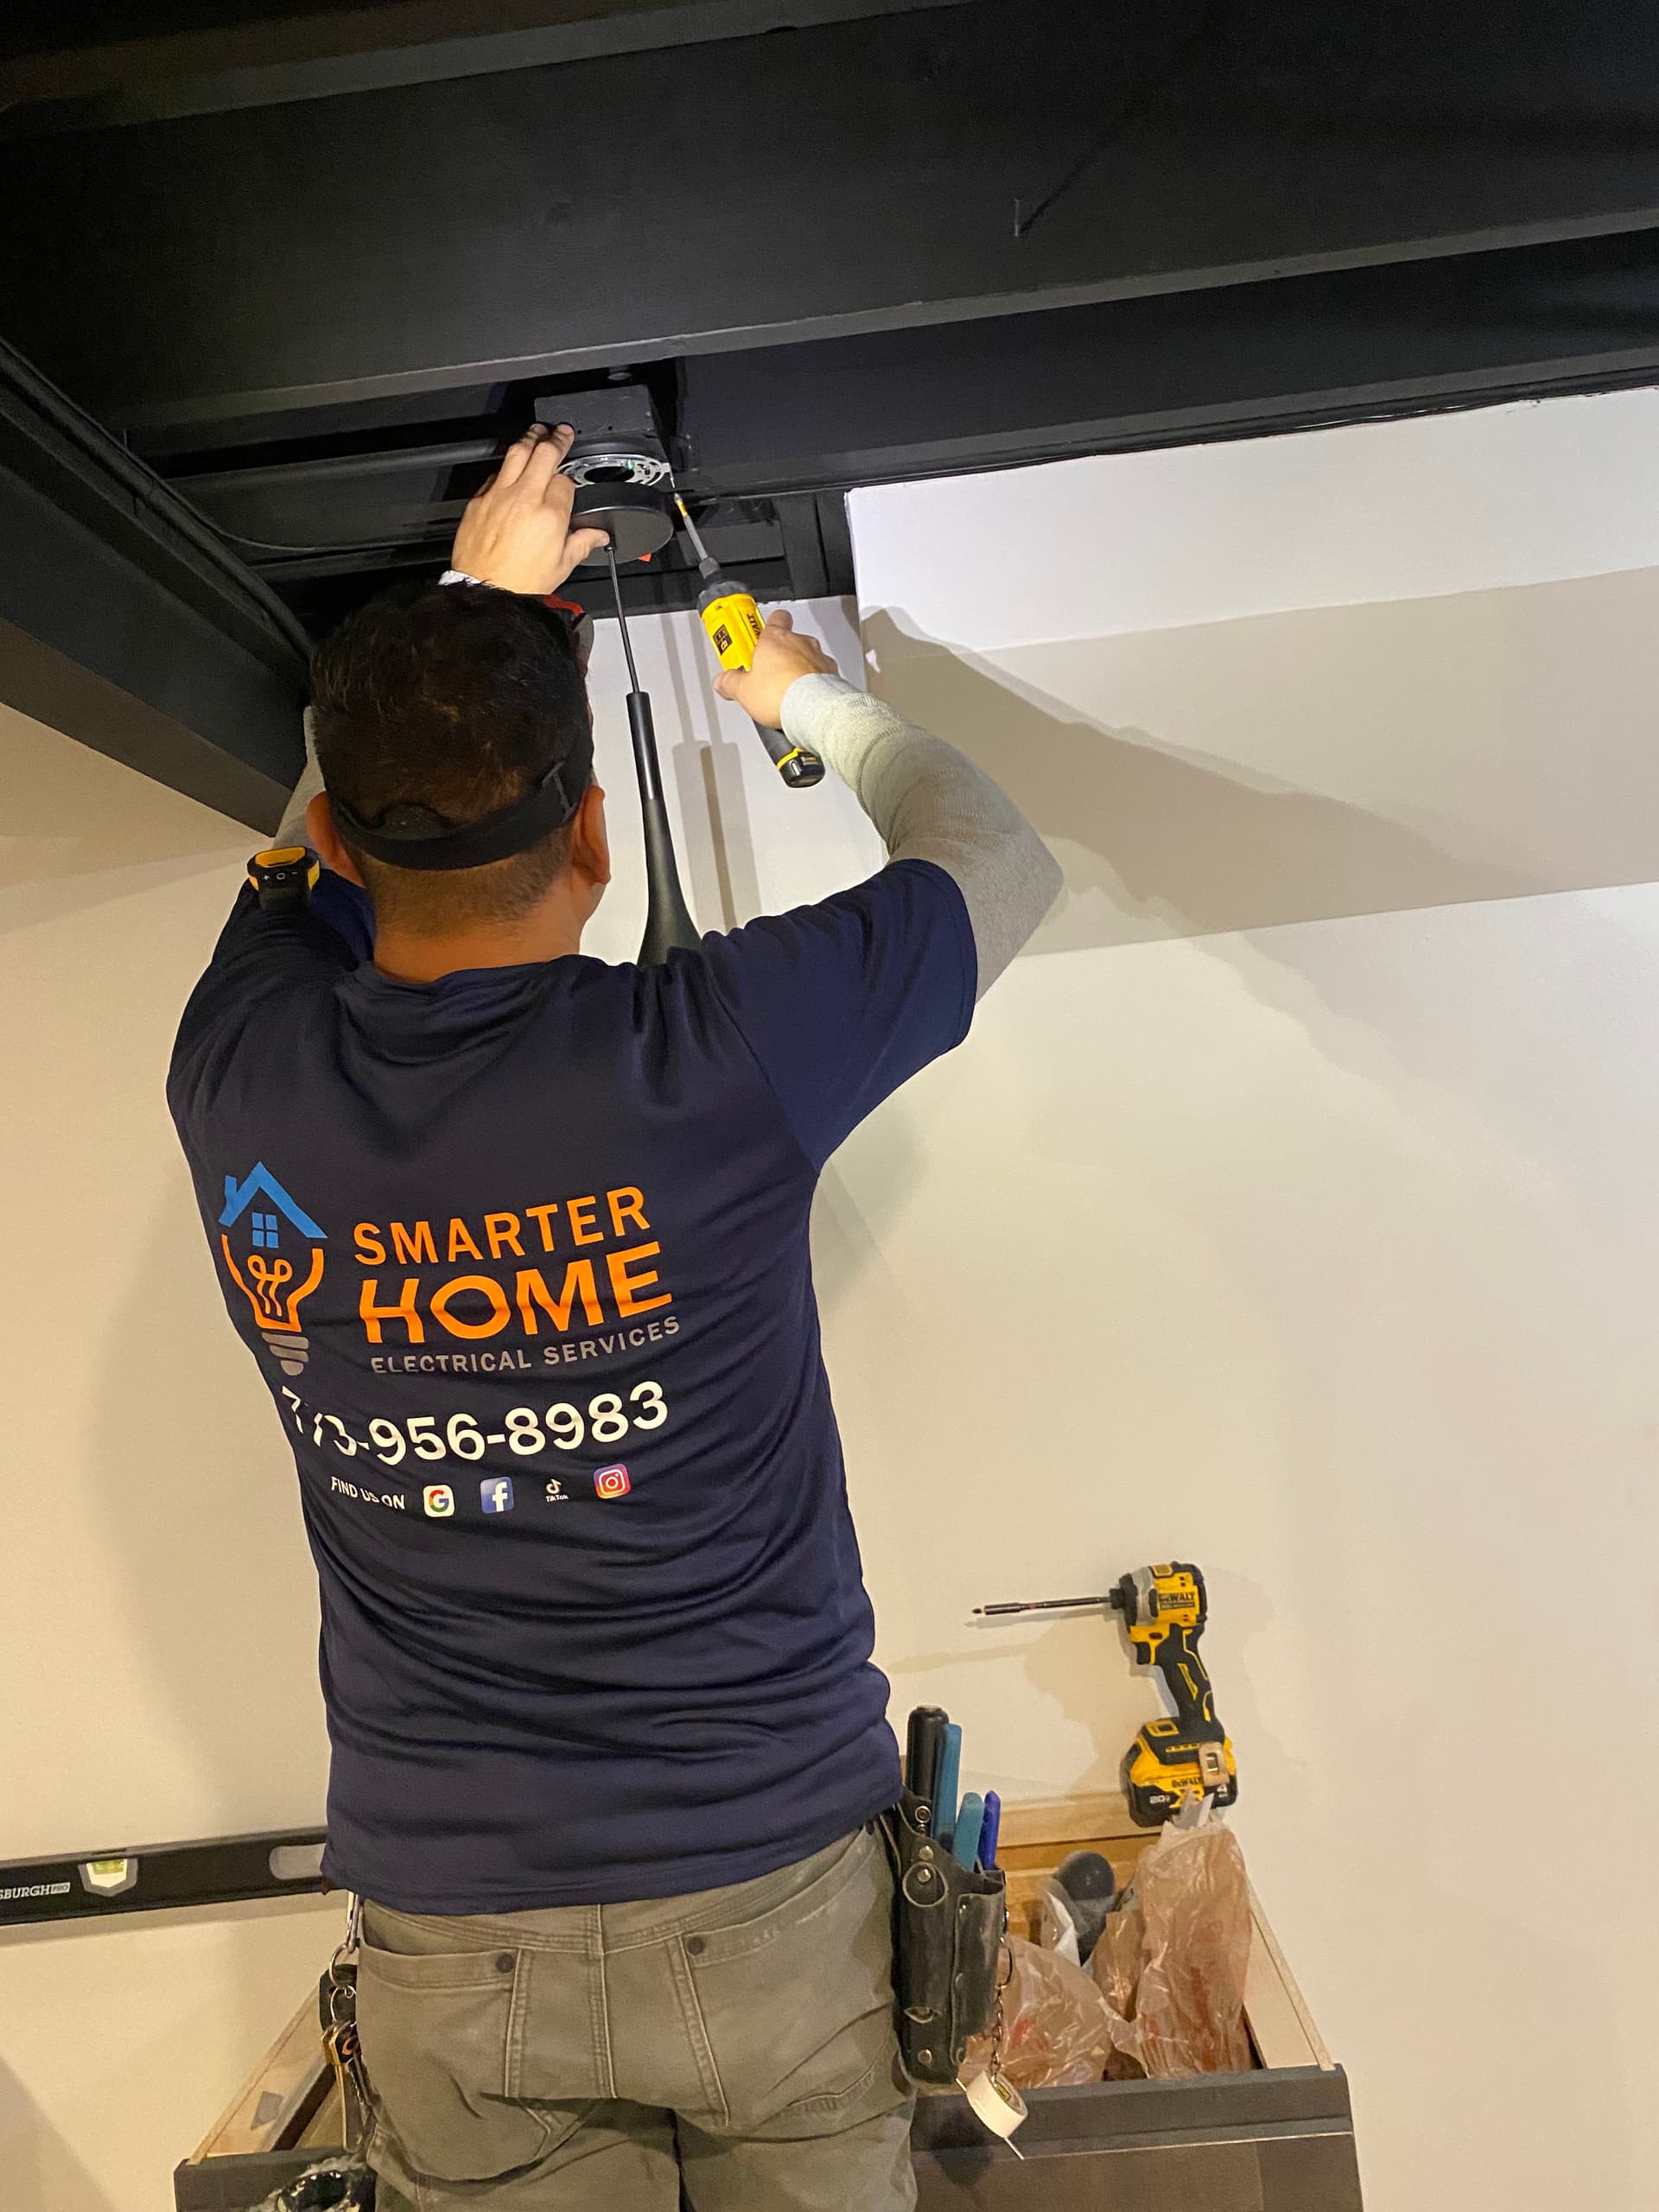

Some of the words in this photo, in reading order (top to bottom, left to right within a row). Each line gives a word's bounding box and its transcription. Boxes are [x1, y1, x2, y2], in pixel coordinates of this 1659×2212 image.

[354, 1186, 651, 1266] SMARTER
[359, 1241, 672, 1344] HOME
[371, 1349, 532, 1374] ELECTRICAL
[543, 1315, 680, 1365] SERVICES
[331, 1476, 359, 1498] FIND
[359, 1488, 380, 1503] US
[380, 1494, 405, 1510] ON
[545, 1494, 569, 1503] TikTok
[52, 1884, 69, 1892] PRO
